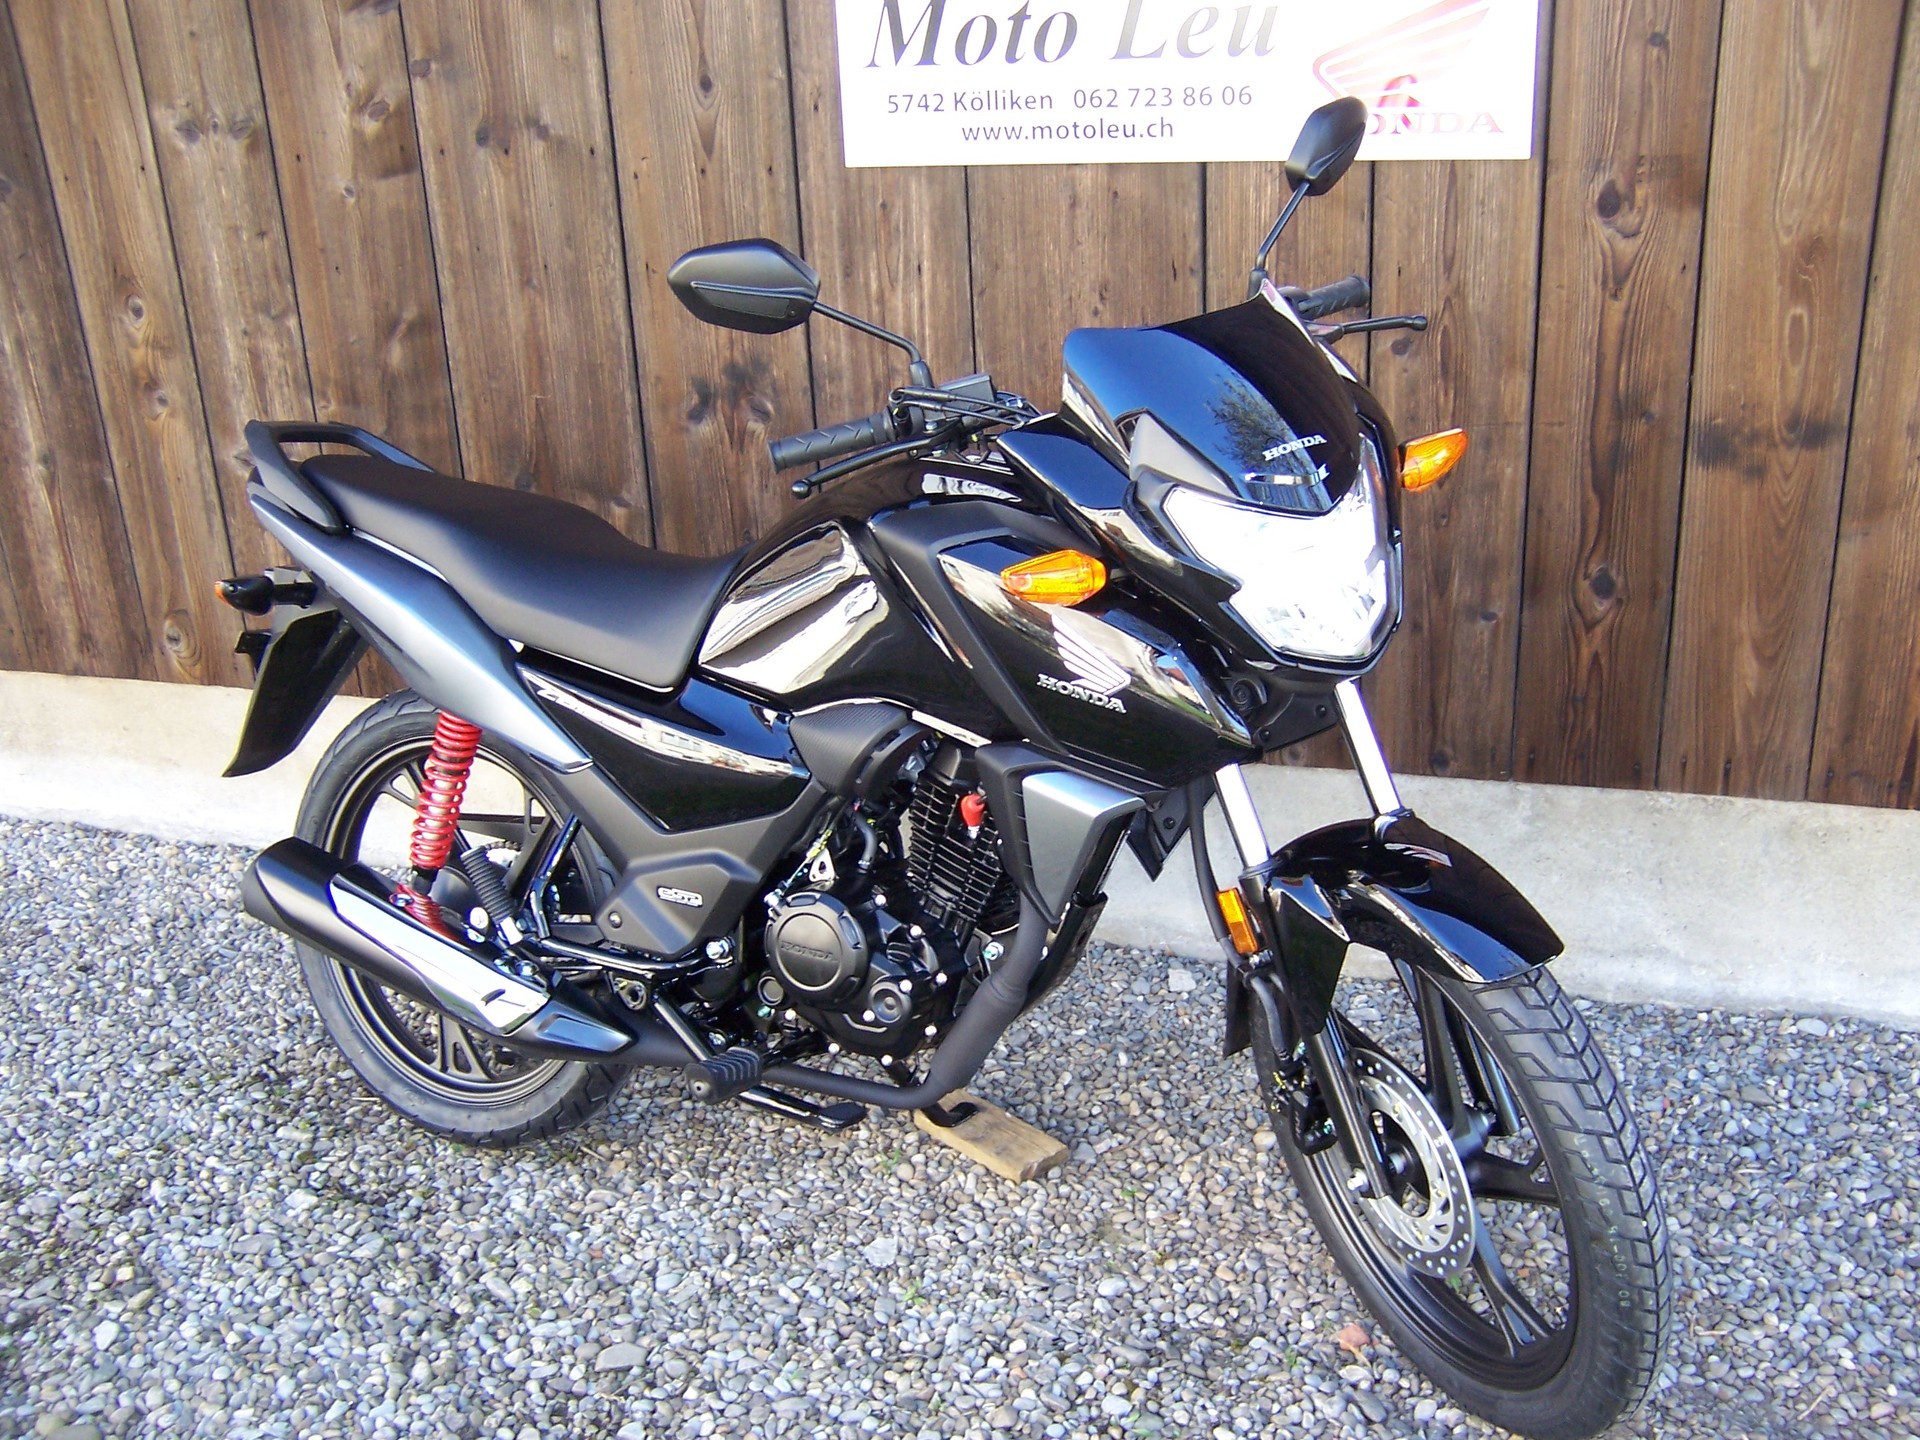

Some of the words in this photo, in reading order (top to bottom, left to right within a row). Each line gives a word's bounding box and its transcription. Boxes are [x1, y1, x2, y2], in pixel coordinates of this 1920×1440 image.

[863, 0, 1078, 68] Moto
[1108, 0, 1279, 60] Leu
[888, 93, 945, 113] 5742
[953, 89, 1053, 112] Kölliken
[1073, 88, 1119, 109] 062
[1127, 87, 1173, 108] 723
[1183, 86, 1213, 106] 86
[1221, 85, 1252, 106] 06
[961, 116, 1174, 141] www.motoleu.ch
[1366, 111, 1505, 135] ONDA
[1262, 434, 1328, 462] HONDA
[1036, 673, 1127, 714] HONDA
